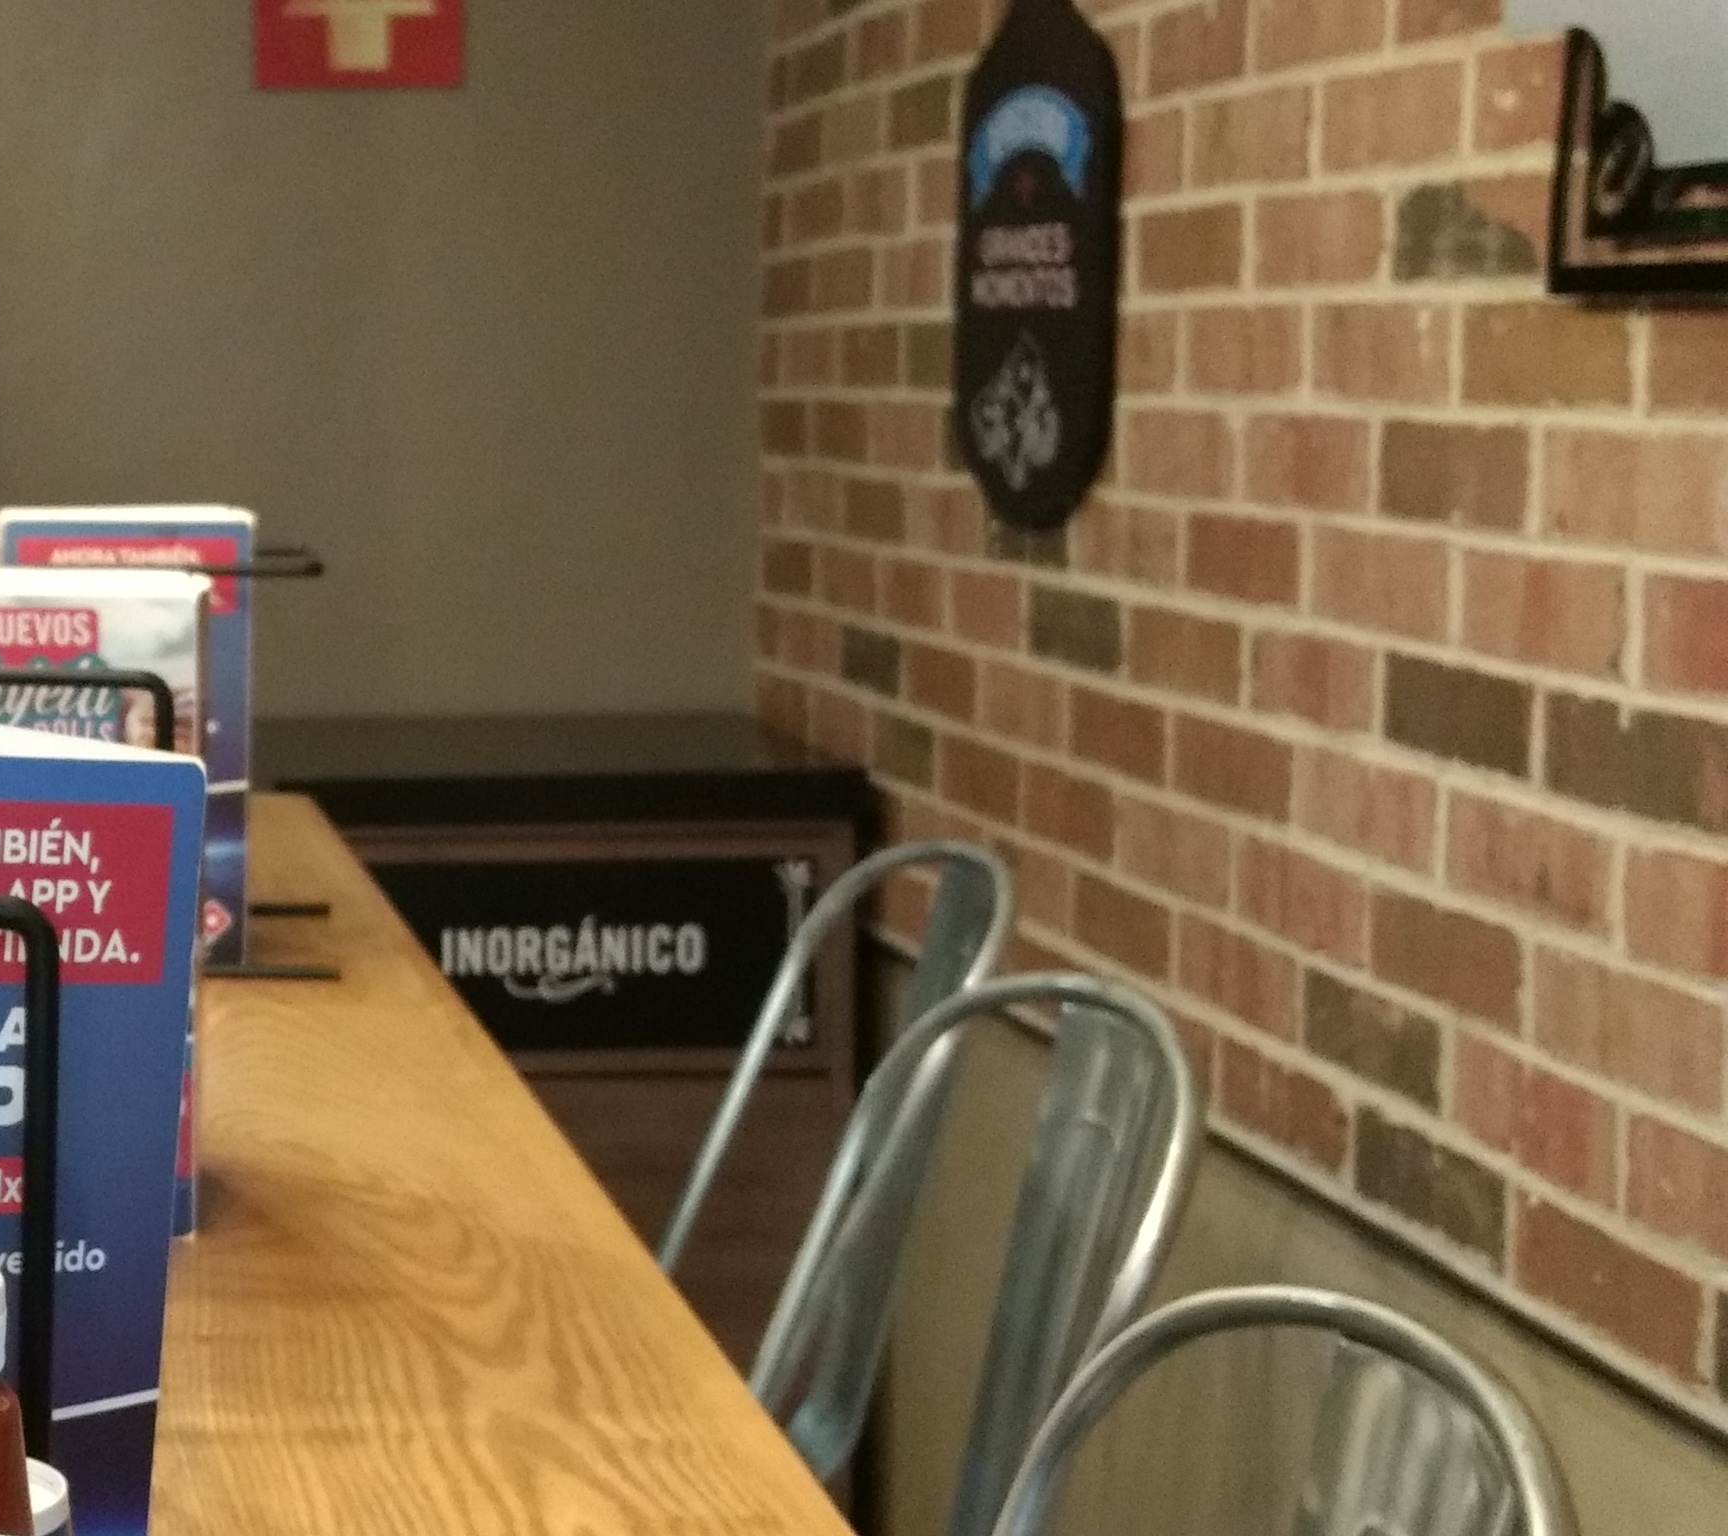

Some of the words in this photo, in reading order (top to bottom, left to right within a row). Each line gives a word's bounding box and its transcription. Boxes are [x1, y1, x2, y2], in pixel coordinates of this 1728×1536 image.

[10, 878, 80, 915] APP
[86, 880, 113, 915] Y
[440, 914, 707, 975] INORGÁNICO
